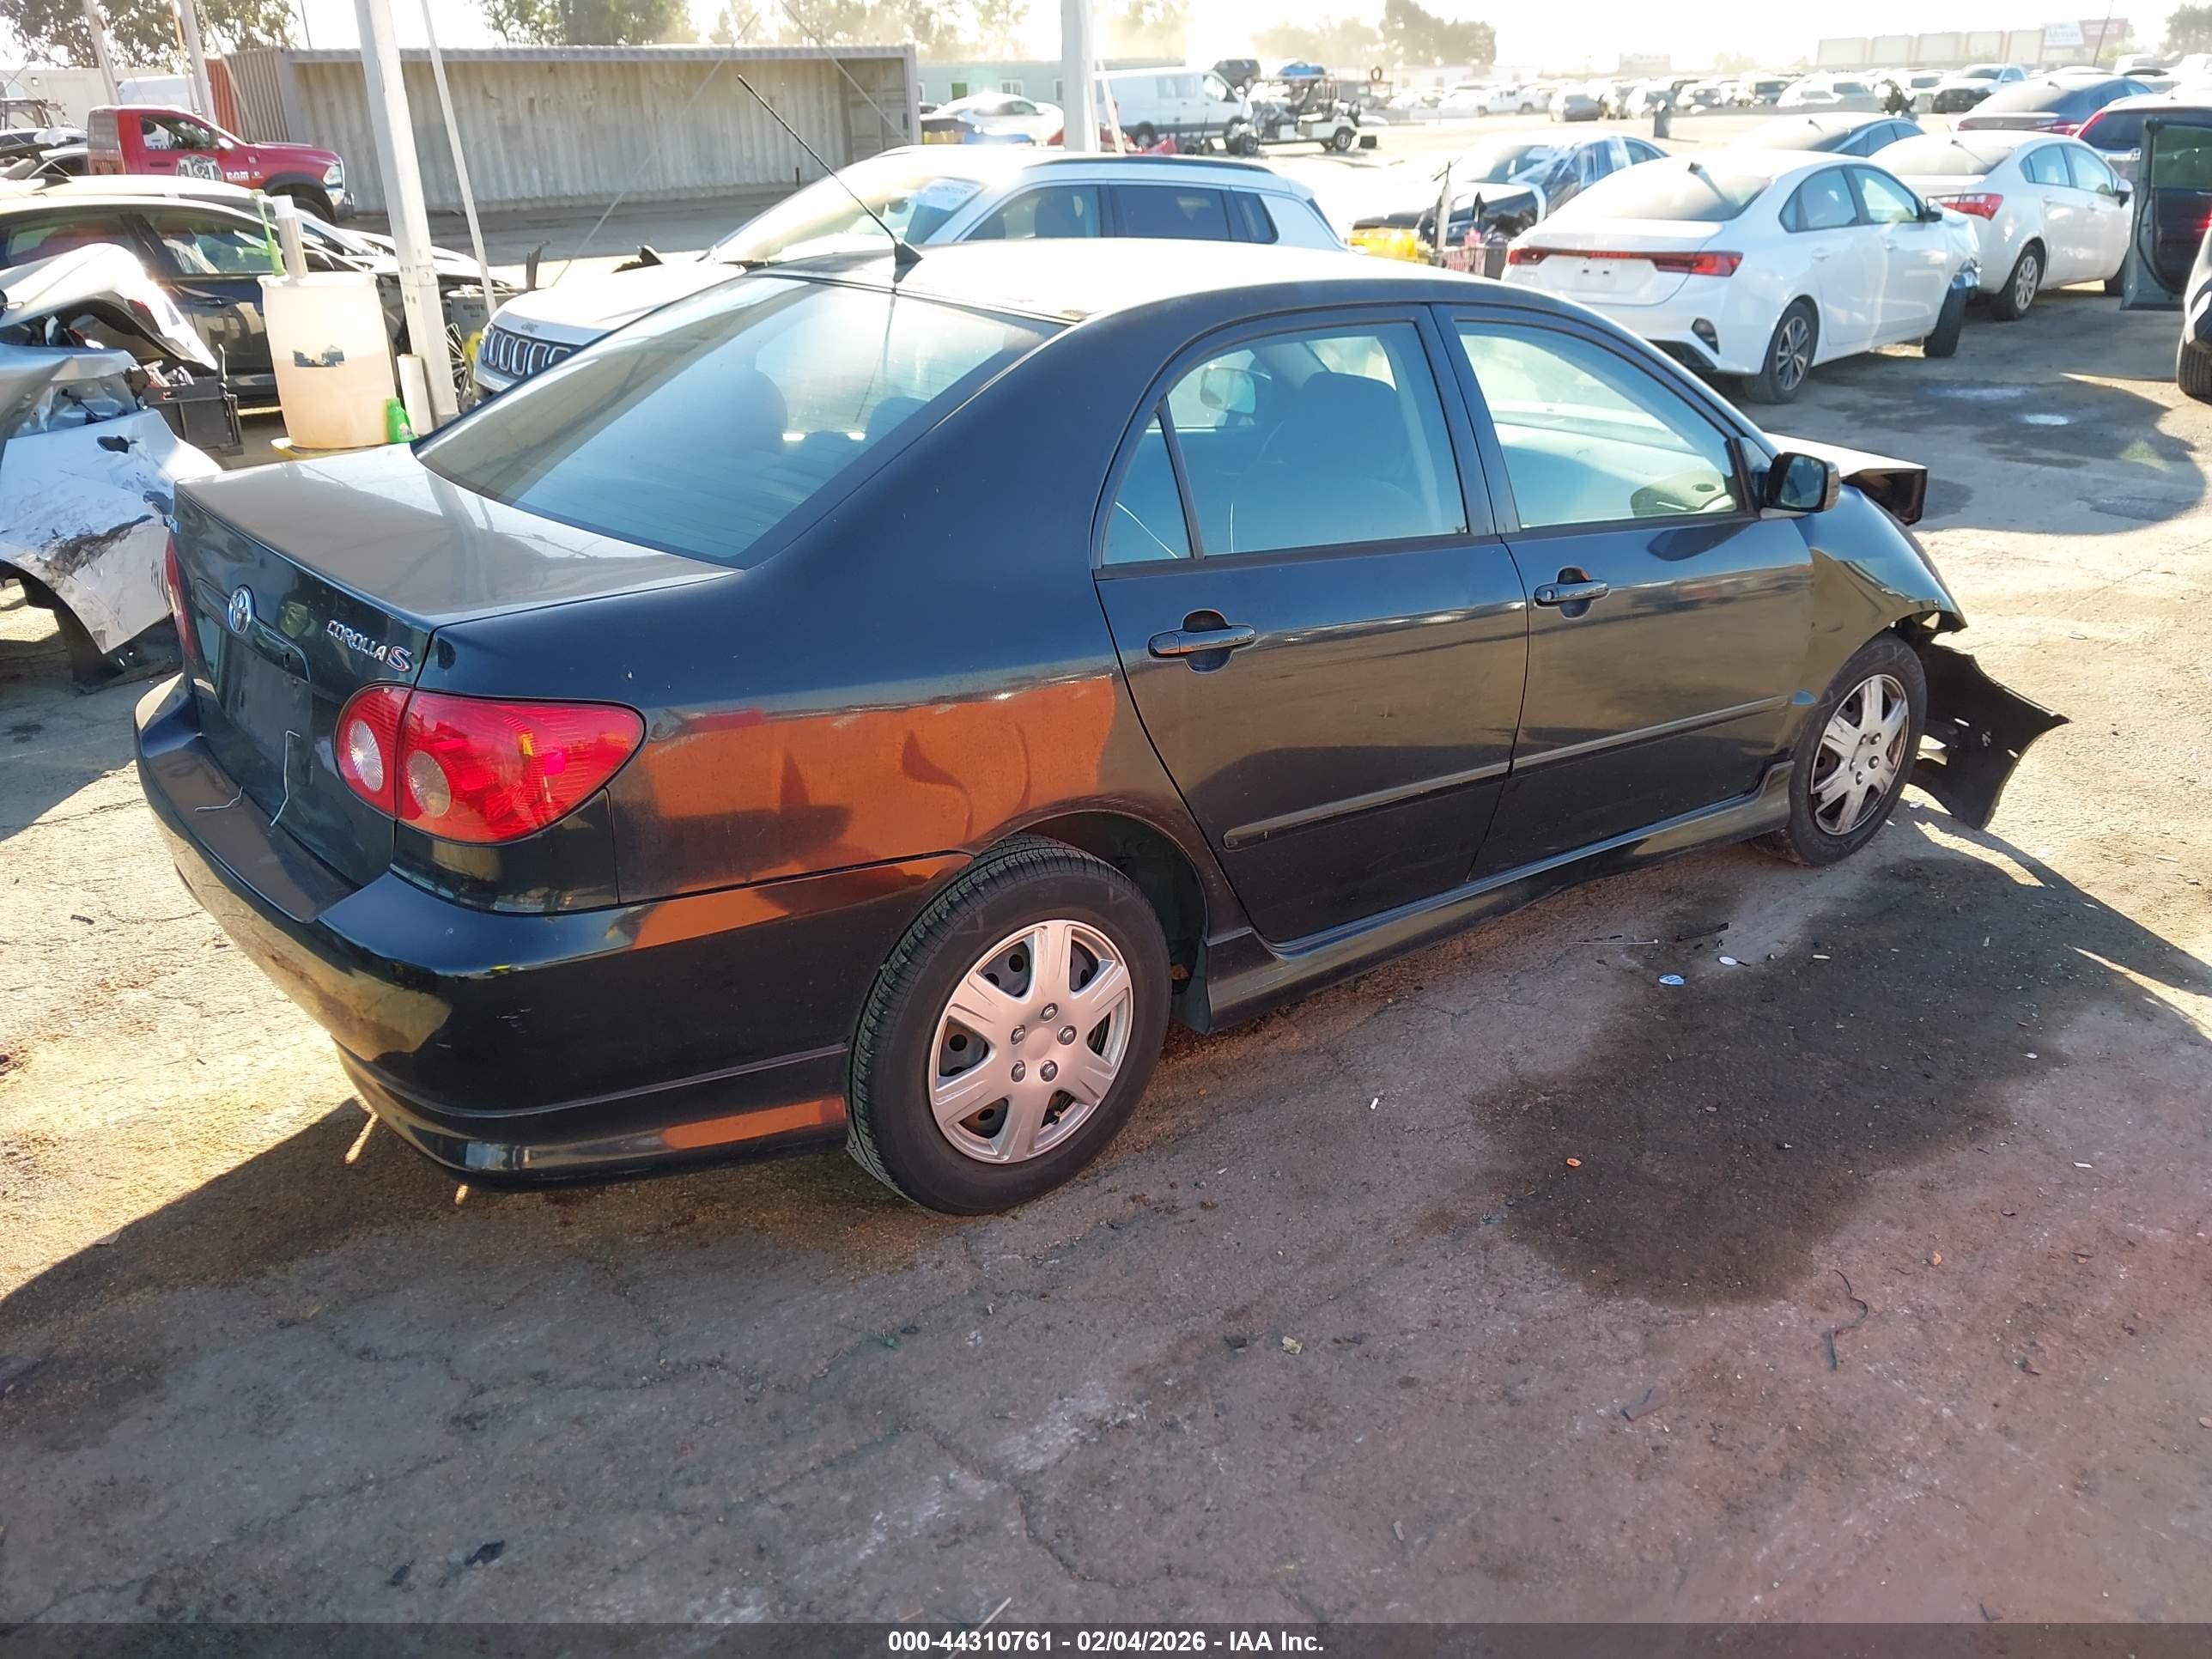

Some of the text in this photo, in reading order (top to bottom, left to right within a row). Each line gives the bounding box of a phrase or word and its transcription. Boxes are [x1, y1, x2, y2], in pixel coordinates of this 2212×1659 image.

[225, 170, 249, 180] RAM
[326, 619, 413, 672] COROLLA S
